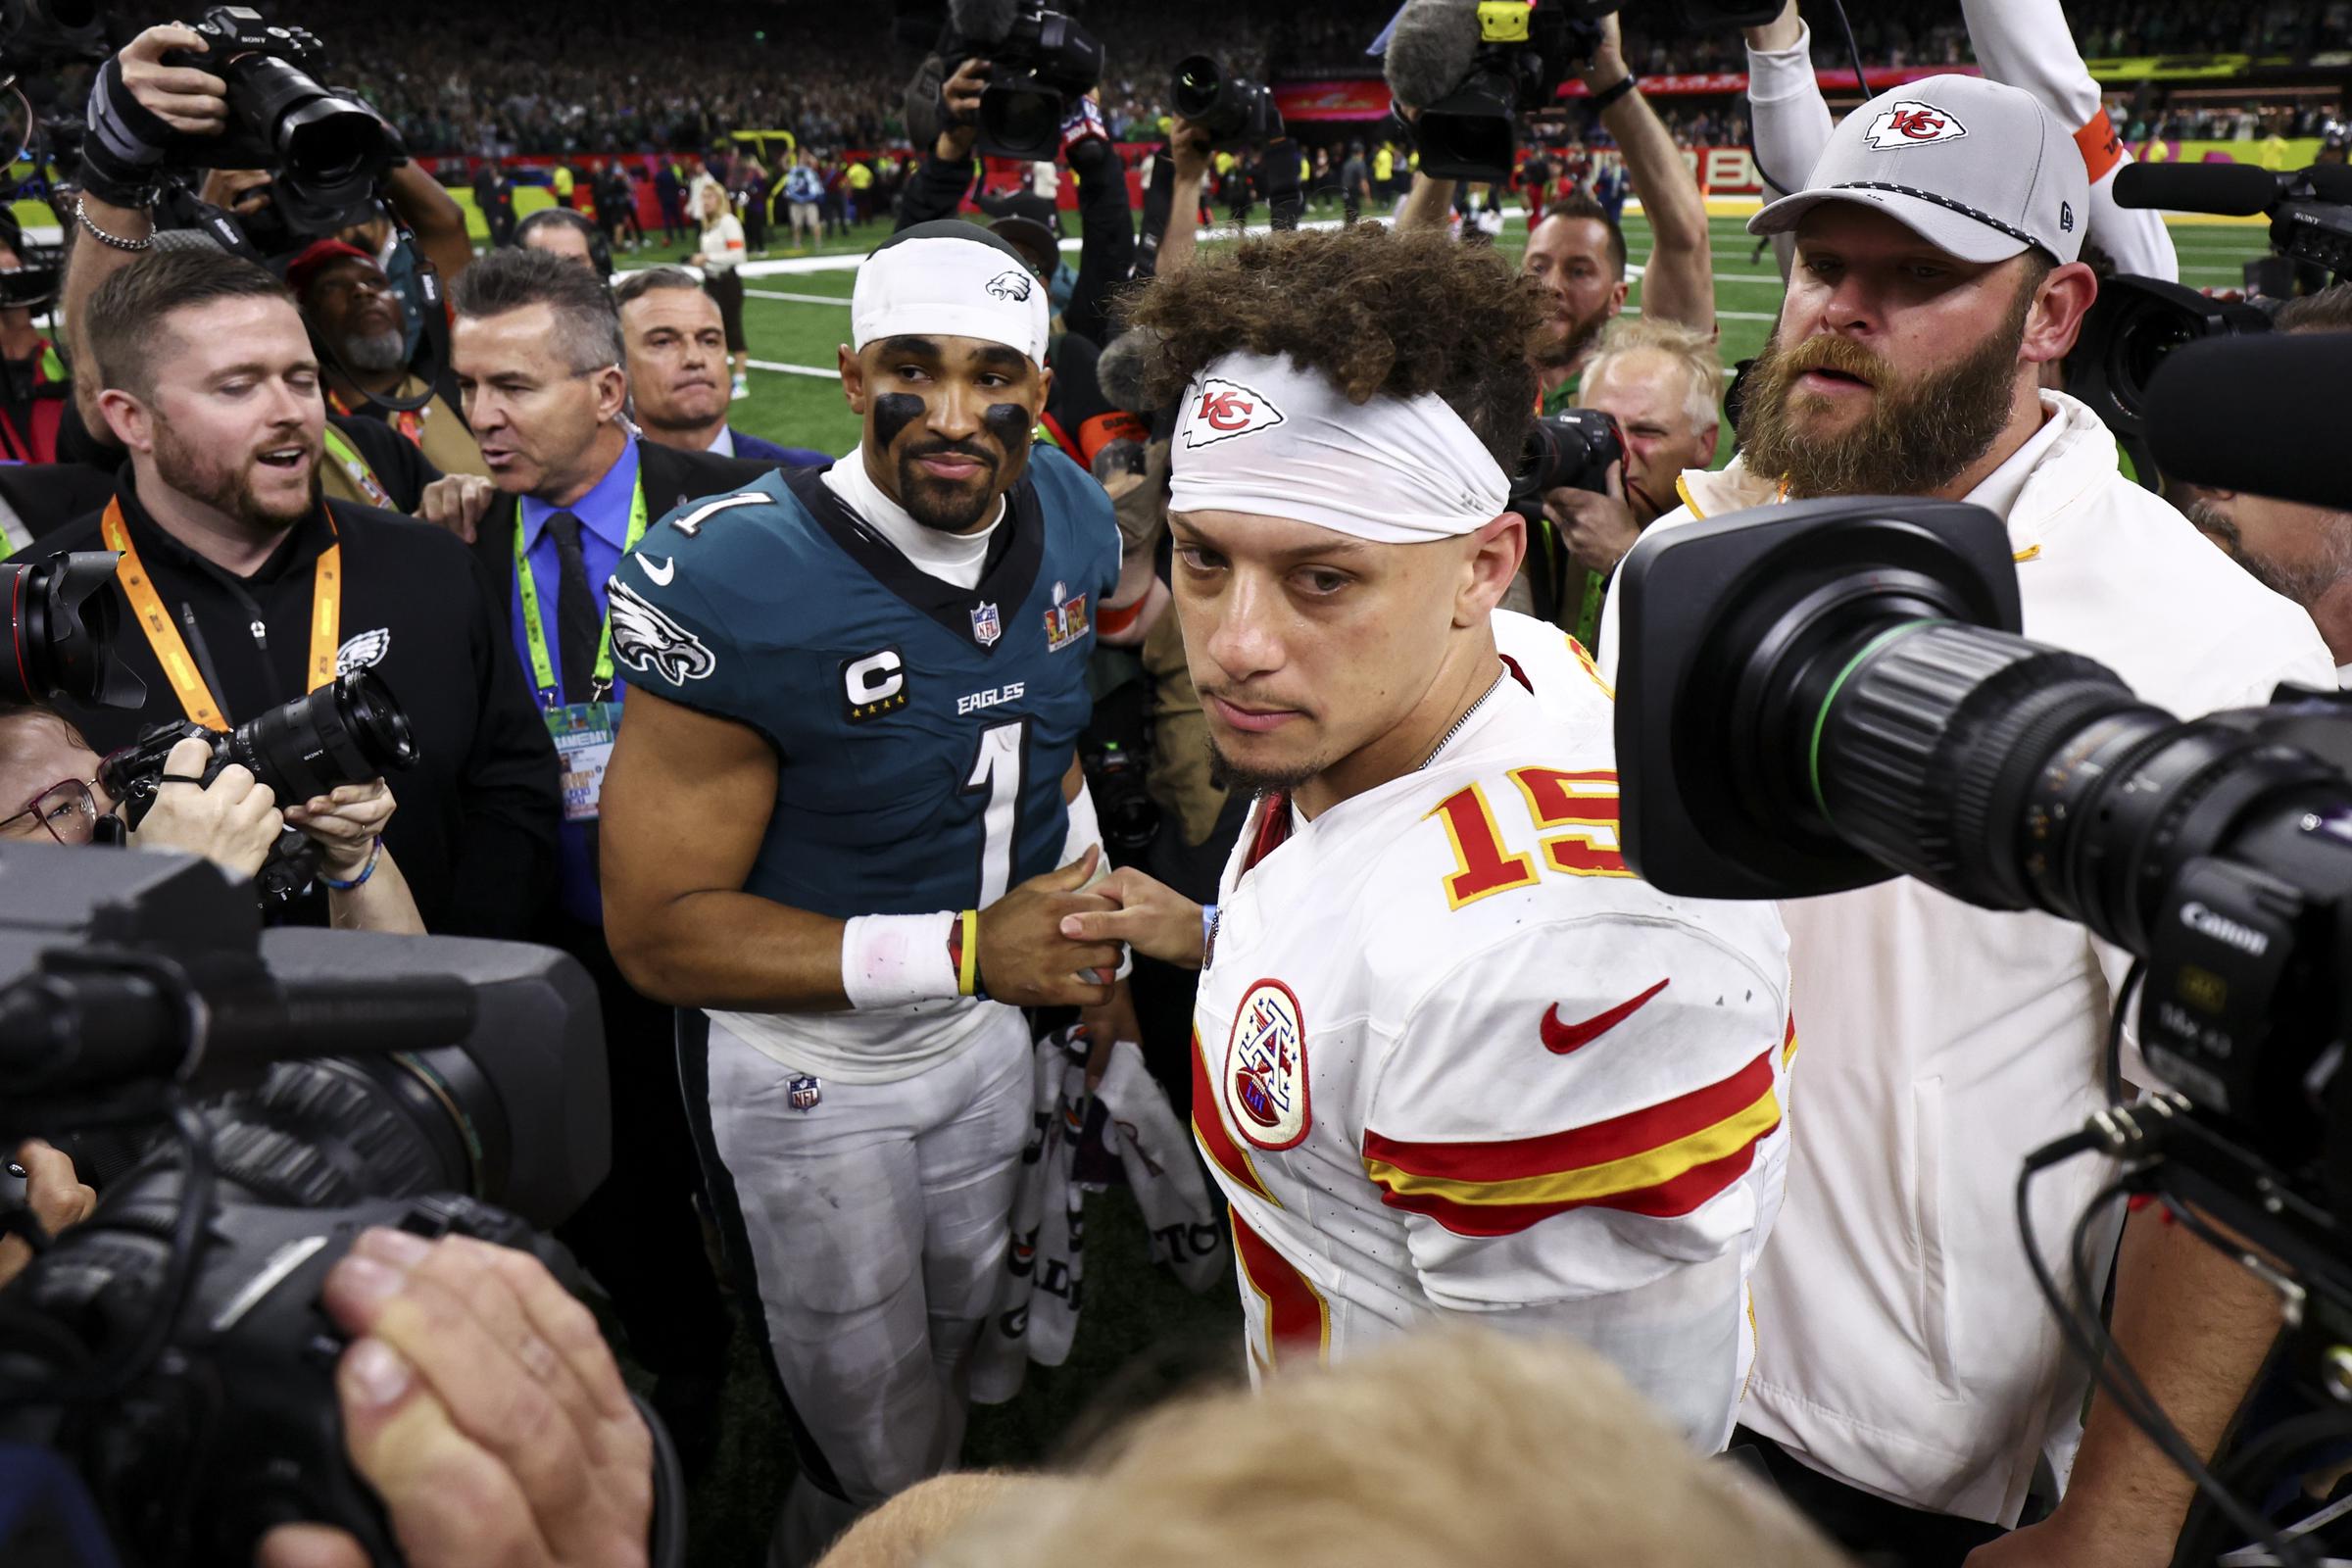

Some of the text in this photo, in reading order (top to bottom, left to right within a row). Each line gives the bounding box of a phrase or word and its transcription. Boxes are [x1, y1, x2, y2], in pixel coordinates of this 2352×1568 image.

[240, 35, 267, 44] SONY
[1886, 110, 1946, 140] KC
[2293, 212, 2321, 225] SONY
[1198, 391, 1254, 431] KC
[976, 621, 998, 639] NFL
[845, 650, 904, 706] C
[956, 682, 1025, 715] EAGLES
[303, 749, 323, 760] SONY
[965, 719, 1024, 911] 1
[1420, 765, 1642, 912] 15
[2180, 901, 2270, 957] Canon
[792, 1089, 818, 1107] NFL
